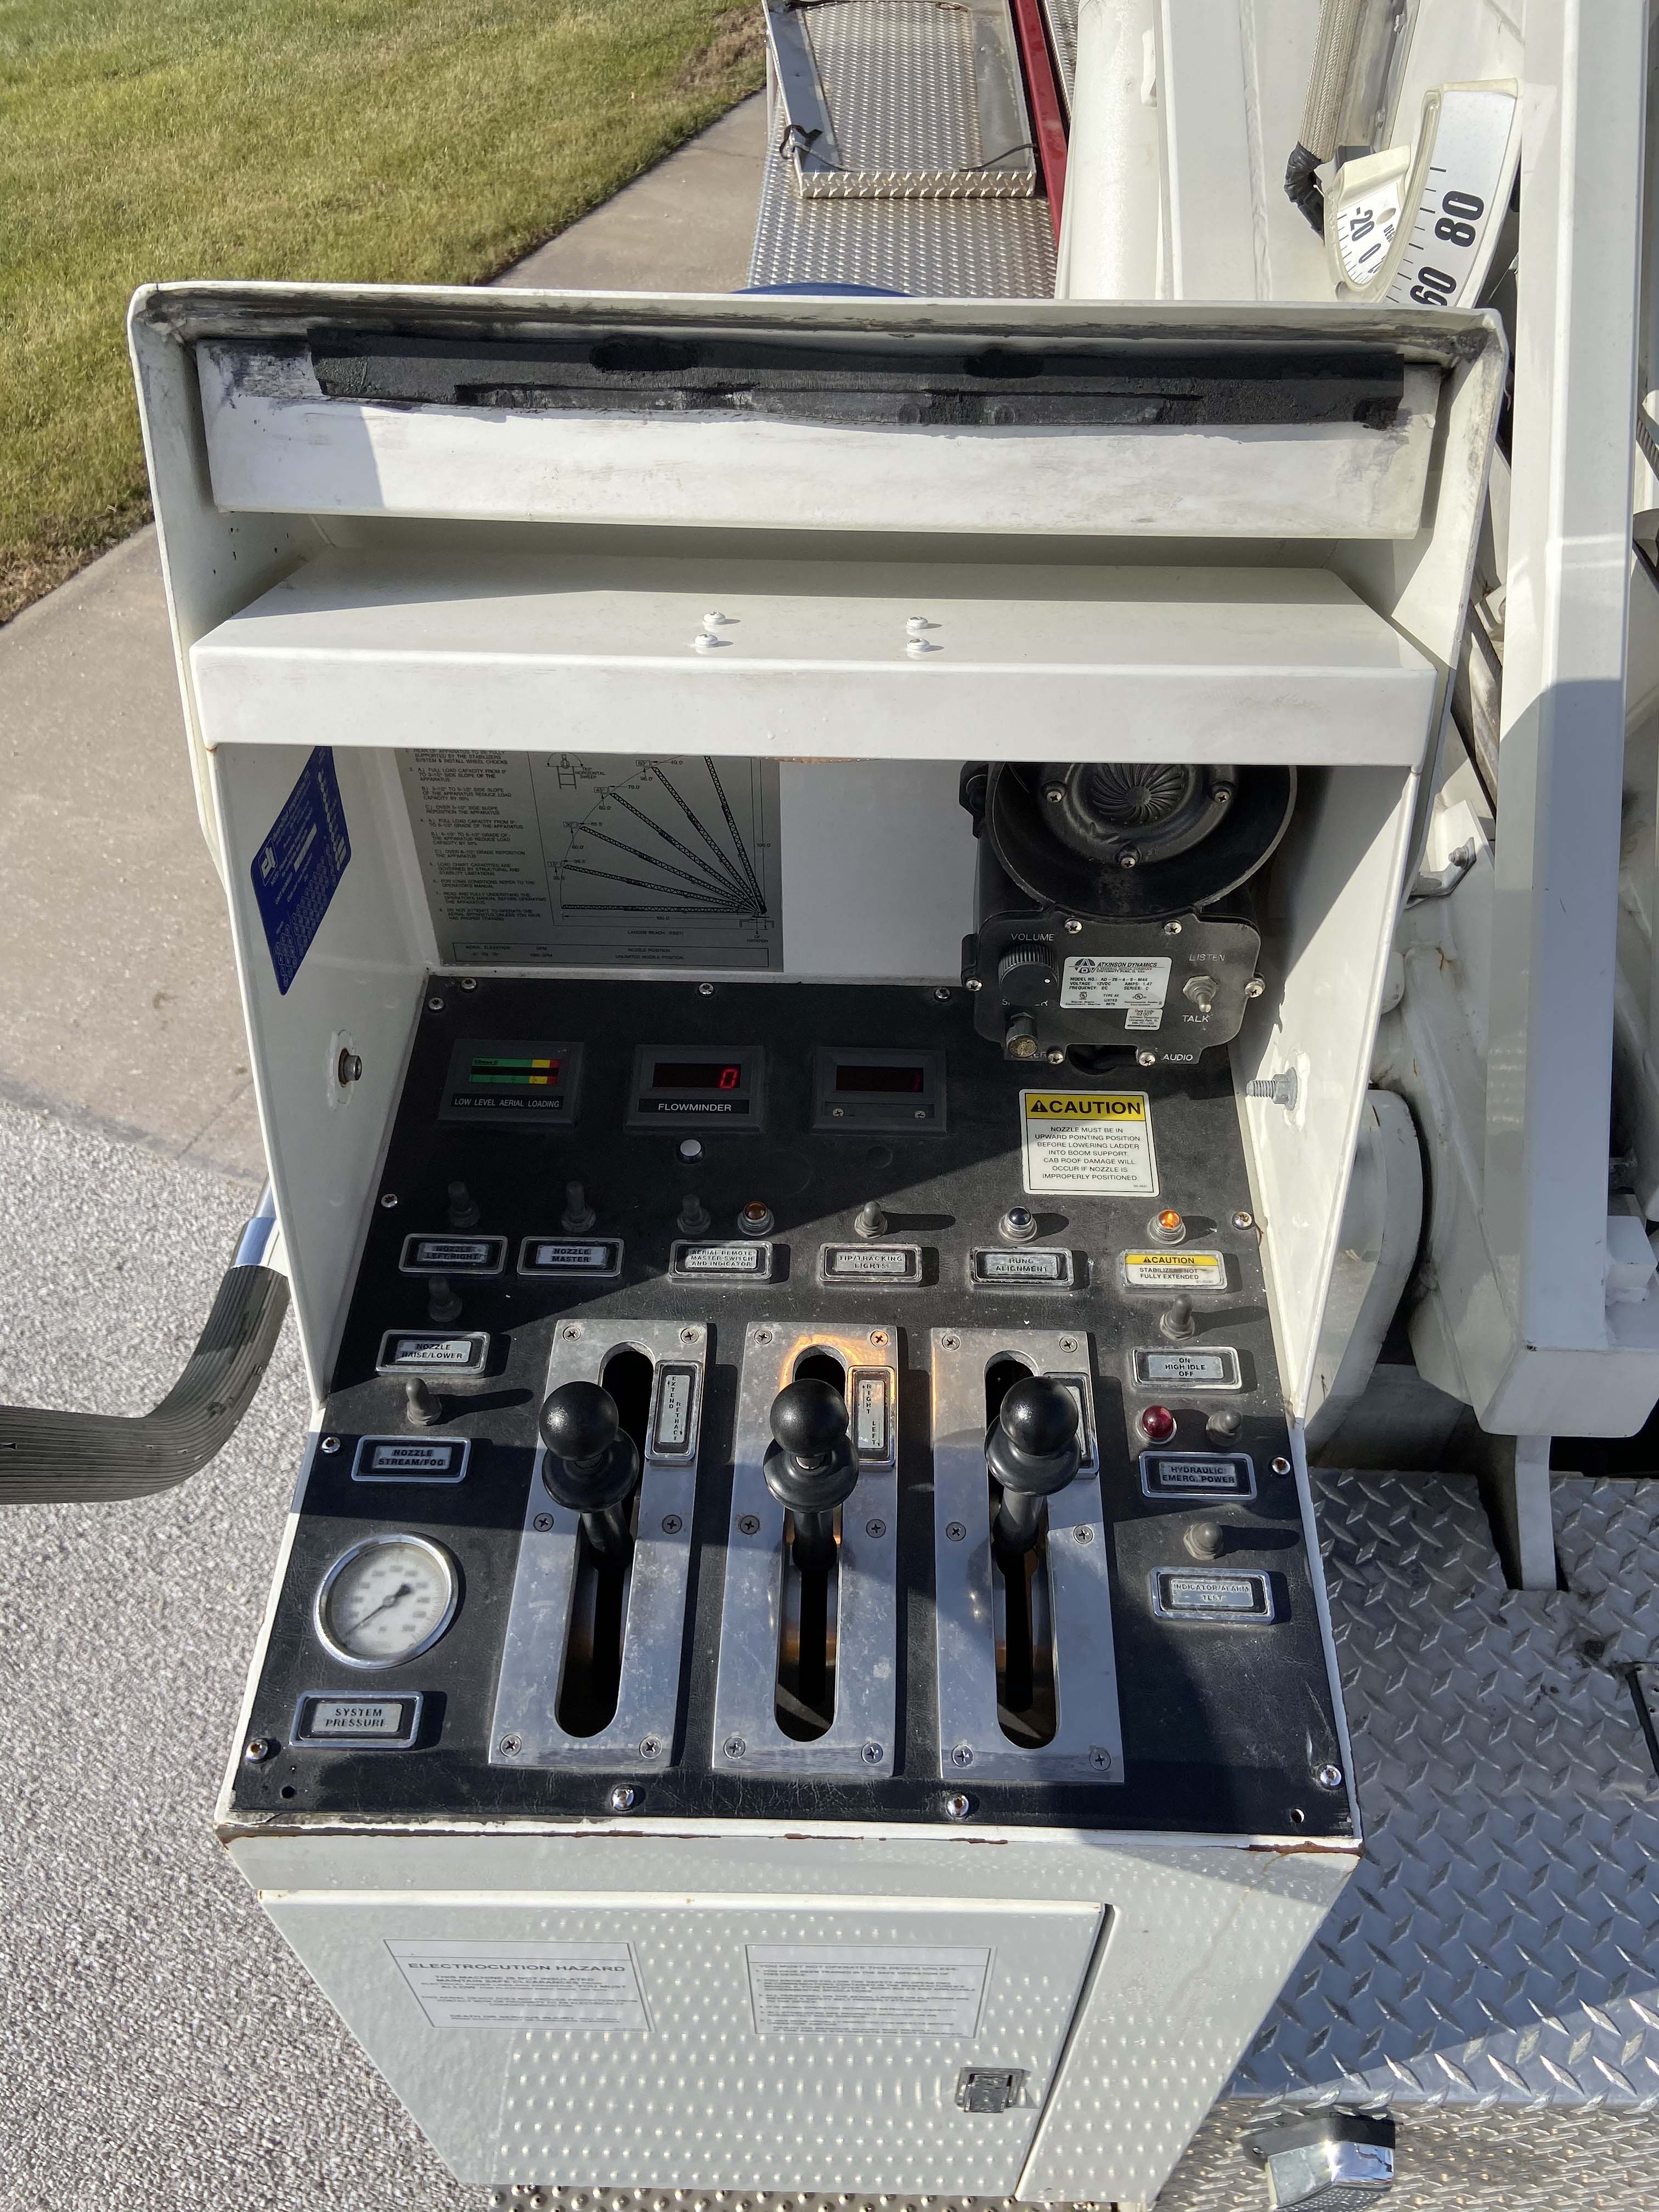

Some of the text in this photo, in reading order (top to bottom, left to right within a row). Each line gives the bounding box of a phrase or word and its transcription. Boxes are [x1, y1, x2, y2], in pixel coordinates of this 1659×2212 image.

[1435, 190, 1483, 247] 80
[1358, 243, 1381, 263] 0
[1410, 266, 1457, 306] 60
[1189, 953, 1225, 962] LISTEN
[1182, 1014, 1210, 1023] TALK
[1163, 1053, 1193, 1062] AUDIO
[720, 1069, 738, 1090] 0
[658, 1103, 732, 1111] FLOWMINDER
[1049, 1101, 1141, 1115] CAUTION
[996, 1265, 1048, 1273] ALIGNMENT
[401, 1351, 462, 1359] RAISE/LOWER
[393, 1449, 433, 1457] NOZZLE
[378, 1457, 444, 1466] STREAM/FOG
[1171, 1466, 1224, 1475] HYDRAULIC
[1162, 1474, 1235, 1483] EMERG. POWER
[1173, 1583, 1250, 1593] INDICATOR/ALARM
[335, 1708, 382, 1717] SYSTEM
[325, 1718, 387, 1729] PRESSURE
